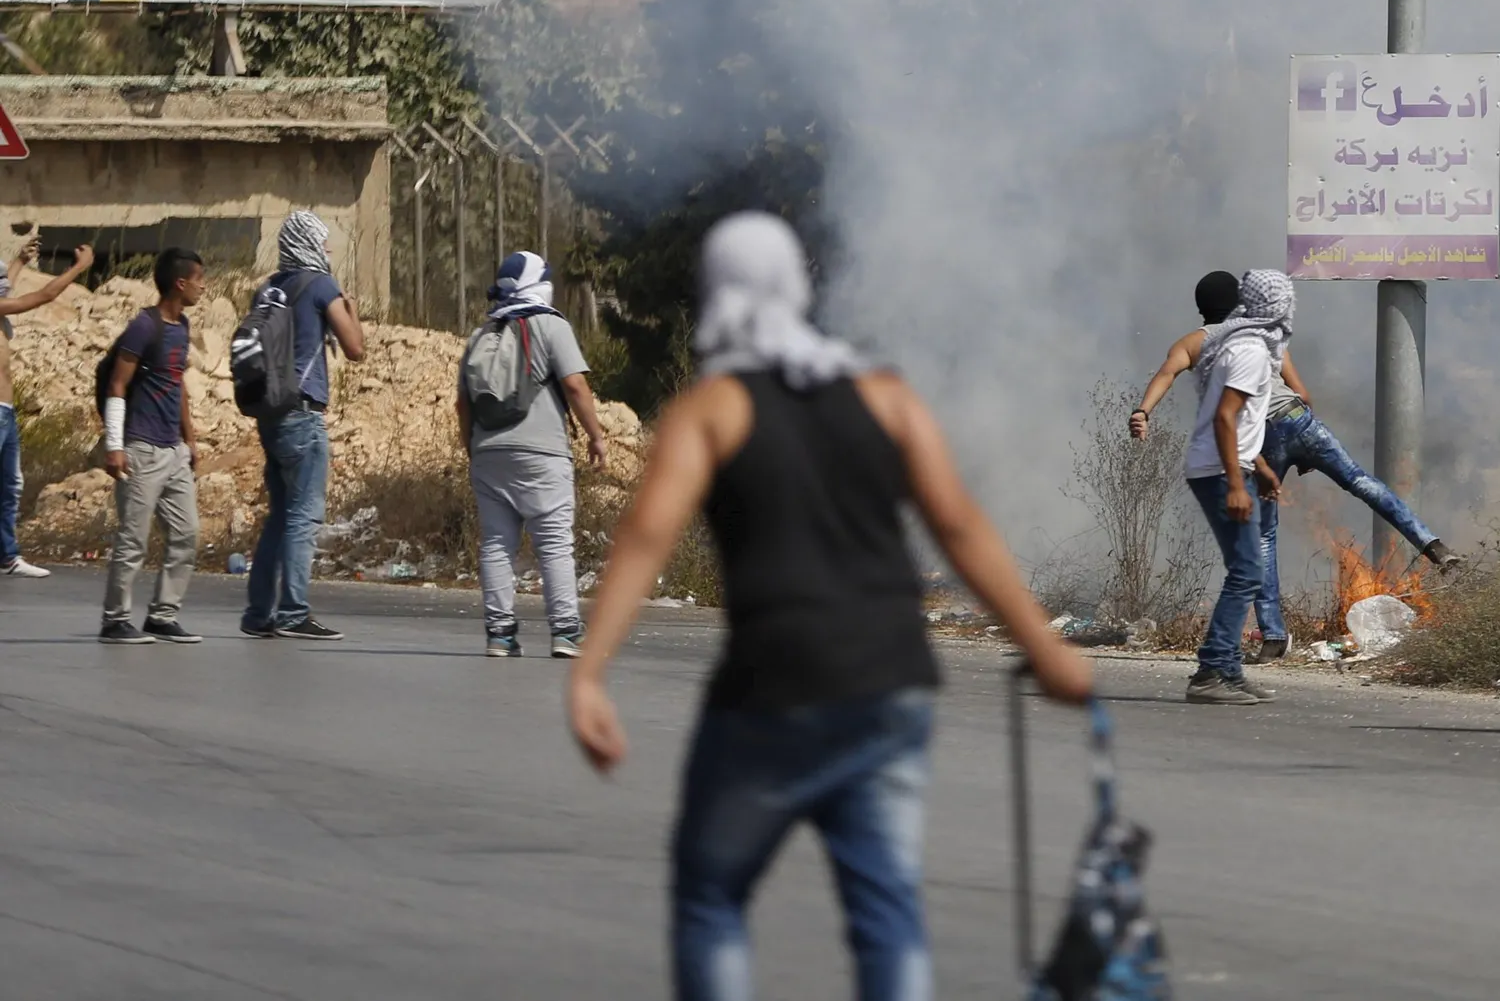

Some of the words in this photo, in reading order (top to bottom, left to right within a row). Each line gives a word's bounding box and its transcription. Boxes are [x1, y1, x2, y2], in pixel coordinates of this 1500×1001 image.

[1377, 75, 1488, 126] أدخل
[1334, 138, 1399, 172] بركة
[1407, 138, 1468, 172] نزيه
[1296, 182, 1386, 222] الأفراح
[1394, 188, 1493, 222] لكرتات
[1302, 245, 1346, 266] الأفضل
[1349, 246, 1395, 266] بالسعر
[1397, 245, 1440, 266] الأجمل
[1444, 247, 1487, 264] تشاهد
